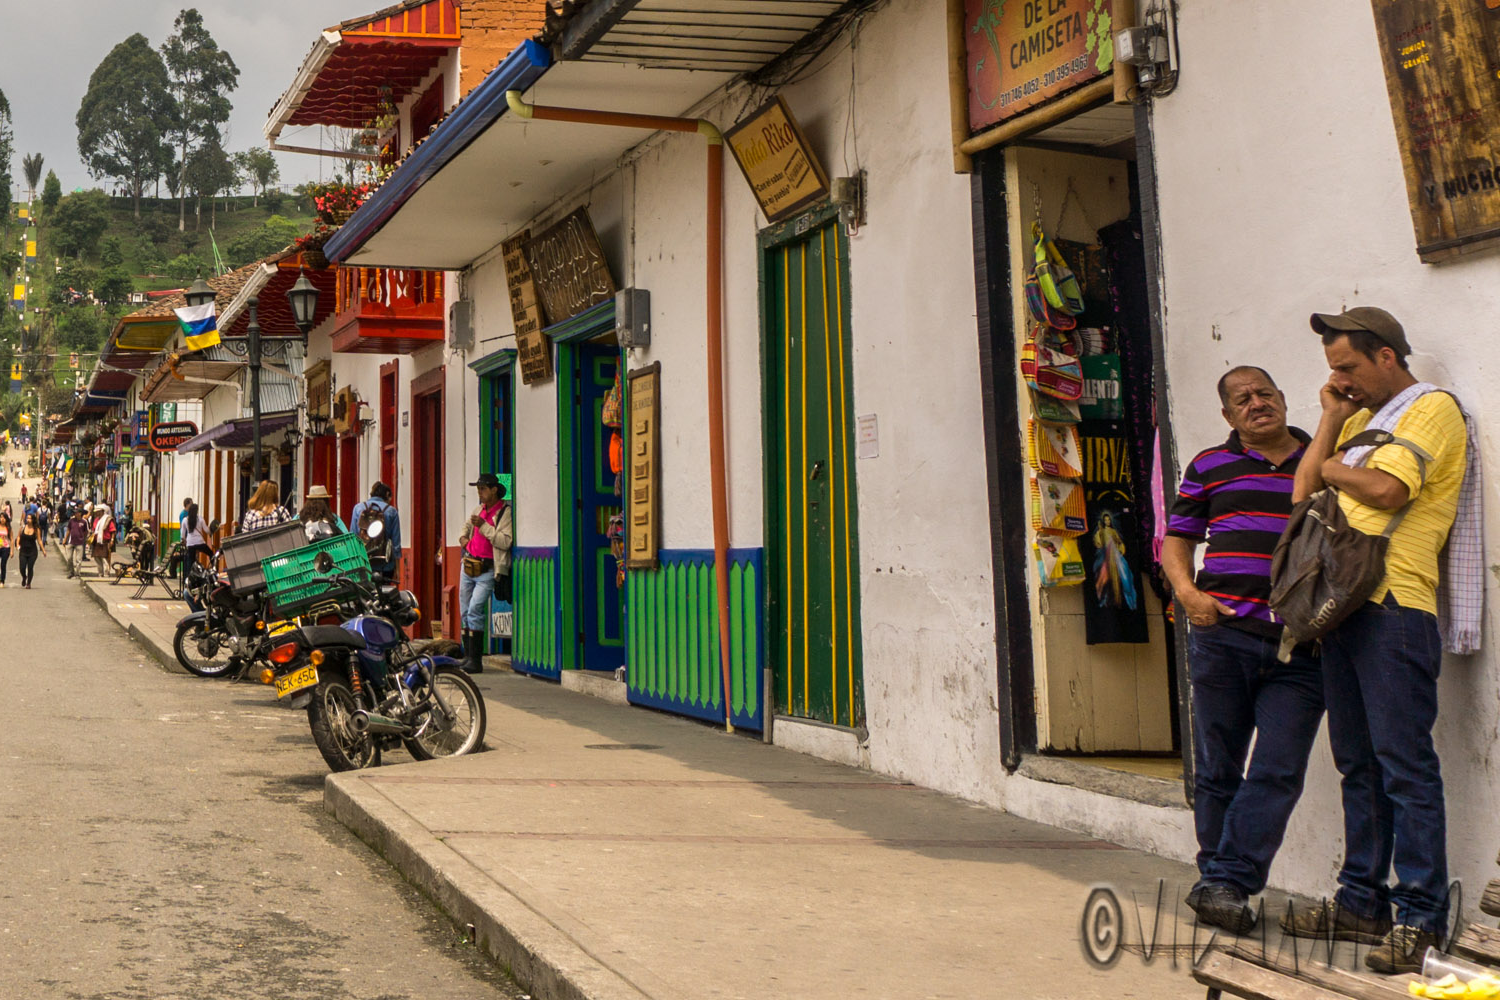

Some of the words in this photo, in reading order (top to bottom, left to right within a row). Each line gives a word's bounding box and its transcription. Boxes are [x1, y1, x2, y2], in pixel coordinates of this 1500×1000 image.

[1009, 11, 1083, 70] CAMISETA
[1401, 40, 1426, 56] JUNIOR
[1403, 53, 1431, 70] GRANDE
[1043, 68, 1056, 87] 310
[734, 137, 769, 171] Todo
[761, 121, 794, 155] Riko
[1082, 378, 1119, 400] ALENTO
[156, 427, 170, 435] MUNDO
[1080, 436, 1130, 485] IRVA
[1309, 598, 1336, 629] TOTTO
